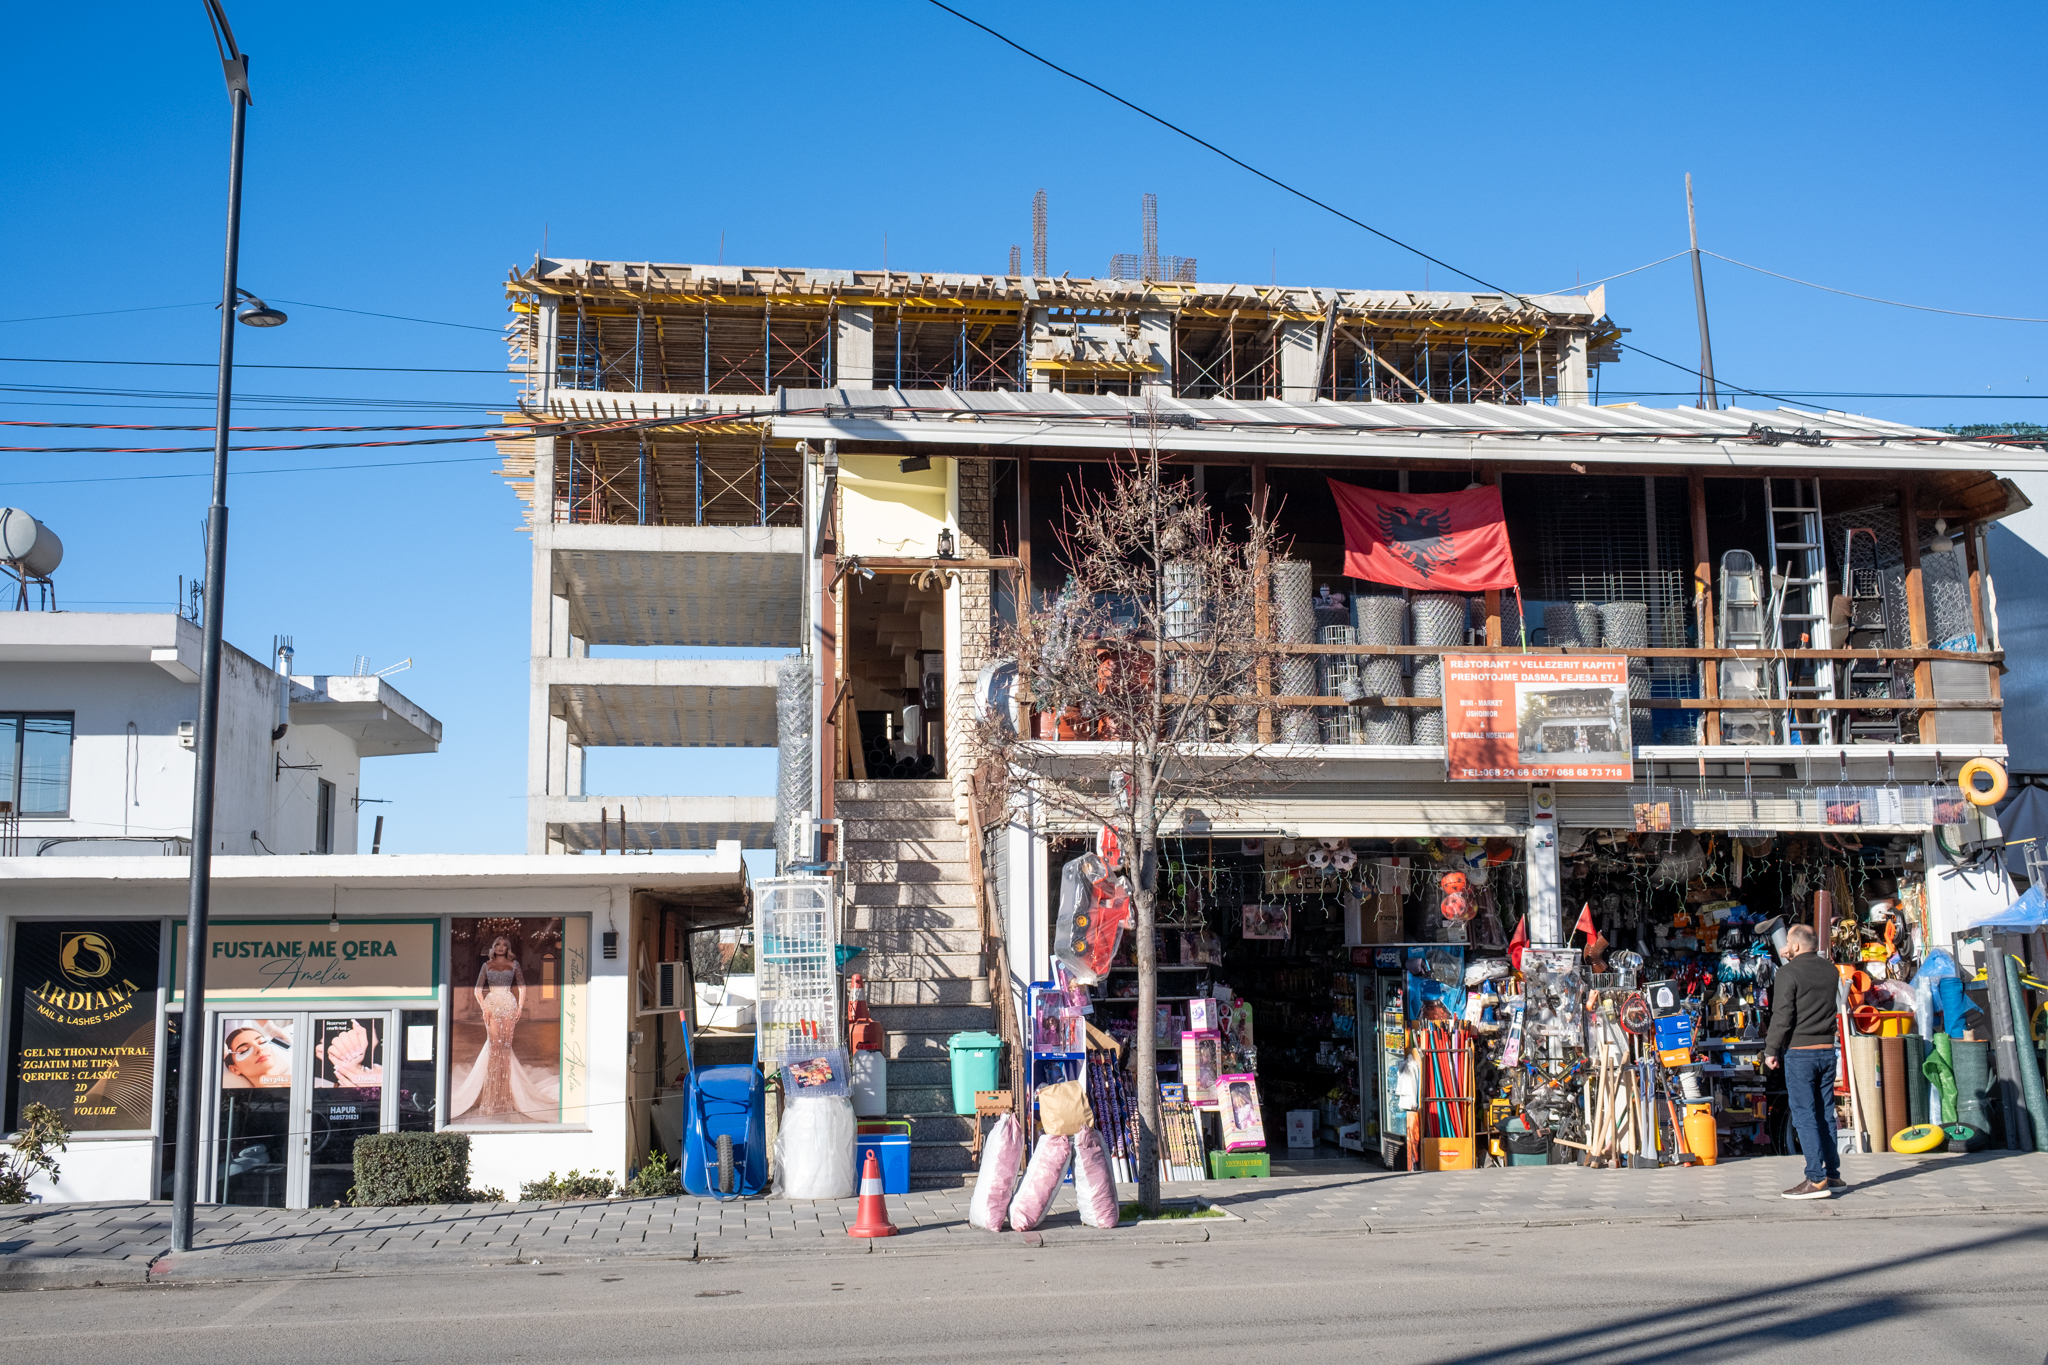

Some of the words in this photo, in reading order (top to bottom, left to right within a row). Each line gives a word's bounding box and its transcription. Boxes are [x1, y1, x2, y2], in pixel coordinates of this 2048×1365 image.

[1450, 660, 1510, 669] RESTORANT
[1520, 661, 1580, 669] VELLEZERIT
[1582, 662, 1616, 670] KAPITI
[1451, 673, 1518, 681] PRENOTOJME
[1521, 674, 1558, 682] DASMA,
[1462, 768, 1501, 777] TEL:068
[1503, 769, 1514, 777] 24
[1518, 769, 1529, 777] 66
[1532, 769, 1549, 777] 687
[1557, 769, 1574, 777] 068
[1576, 769, 1588, 777] 68
[1591, 769, 1602, 777] 73
[1605, 768, 1622, 777] 718
[212, 941, 303, 958] FUSTANE
[308, 941, 337, 958] ME
[342, 940, 398, 960] QERA
[259, 950, 351, 993] Amelia
[569, 946, 584, 990] Fustane
[33, 978, 140, 1010] ARDIANA
[37, 1004, 55, 1020] NAIL
[67, 1016, 102, 1026] LASHES
[104, 1002, 133, 1021] SALON
[24, 1049, 45, 1057] GEL
[47, 1049, 62, 1057] NE
[63, 1048, 98, 1057] THONJ
[100, 1047, 149, 1056] NATYRAL
[23, 1060, 70, 1069] ZGJATIM
[72, 1060, 88, 1068] ME
[90, 1060, 120, 1068] TIPSA
[564, 1041, 585, 1093] Amelia
[22, 1072, 70, 1082] QERPIKE
[77, 1071, 119, 1080] CLASSIC
[74, 1083, 88, 1092] 2D
[74, 1095, 87, 1104] 3D
[74, 1106, 117, 1115] VOLUME
